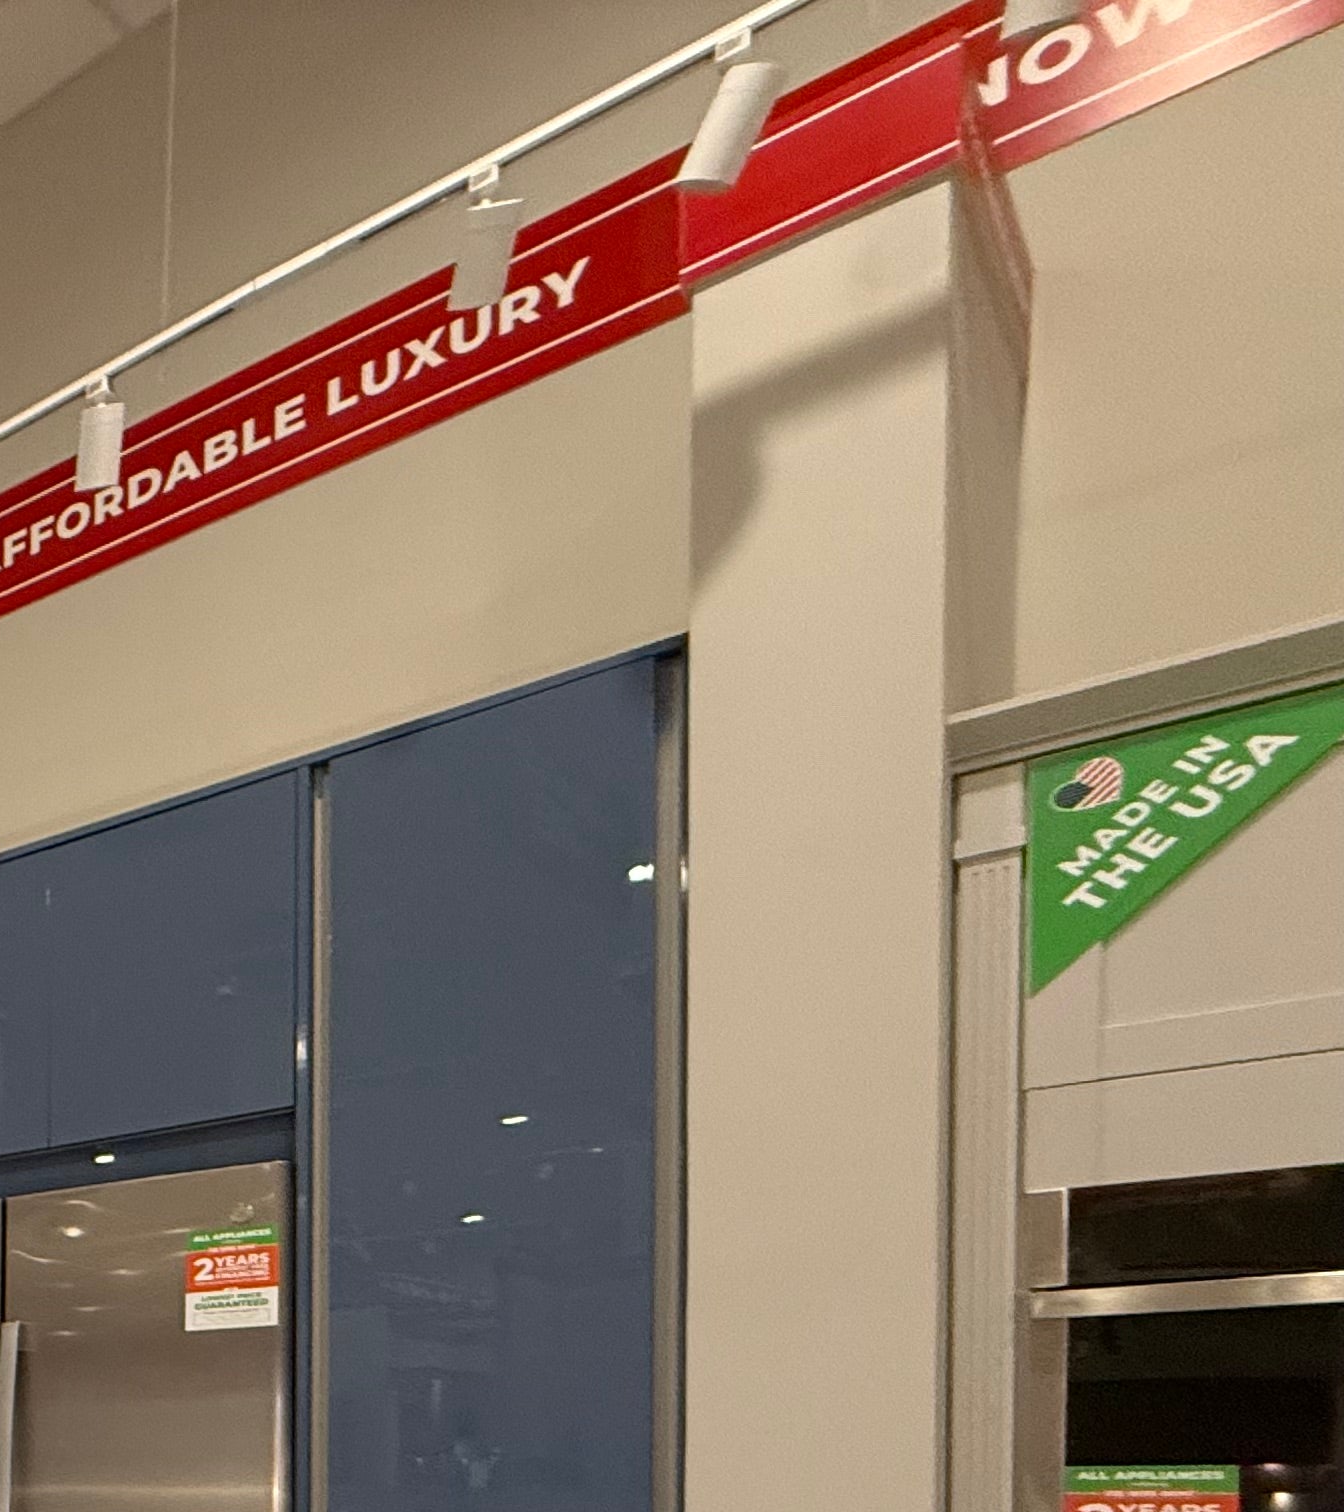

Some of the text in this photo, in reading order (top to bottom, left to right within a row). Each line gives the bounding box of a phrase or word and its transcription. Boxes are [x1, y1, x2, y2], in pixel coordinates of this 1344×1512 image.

[327, 257, 590, 415] LUXURY
[1056, 735, 1230, 876] MADE IN
[1063, 735, 1300, 908] THE USA
[193, 1257, 215, 1281] 2
[214, 1252, 270, 1267] YEARS
[1077, 1470, 1225, 1480] ALL APPLIANCES
